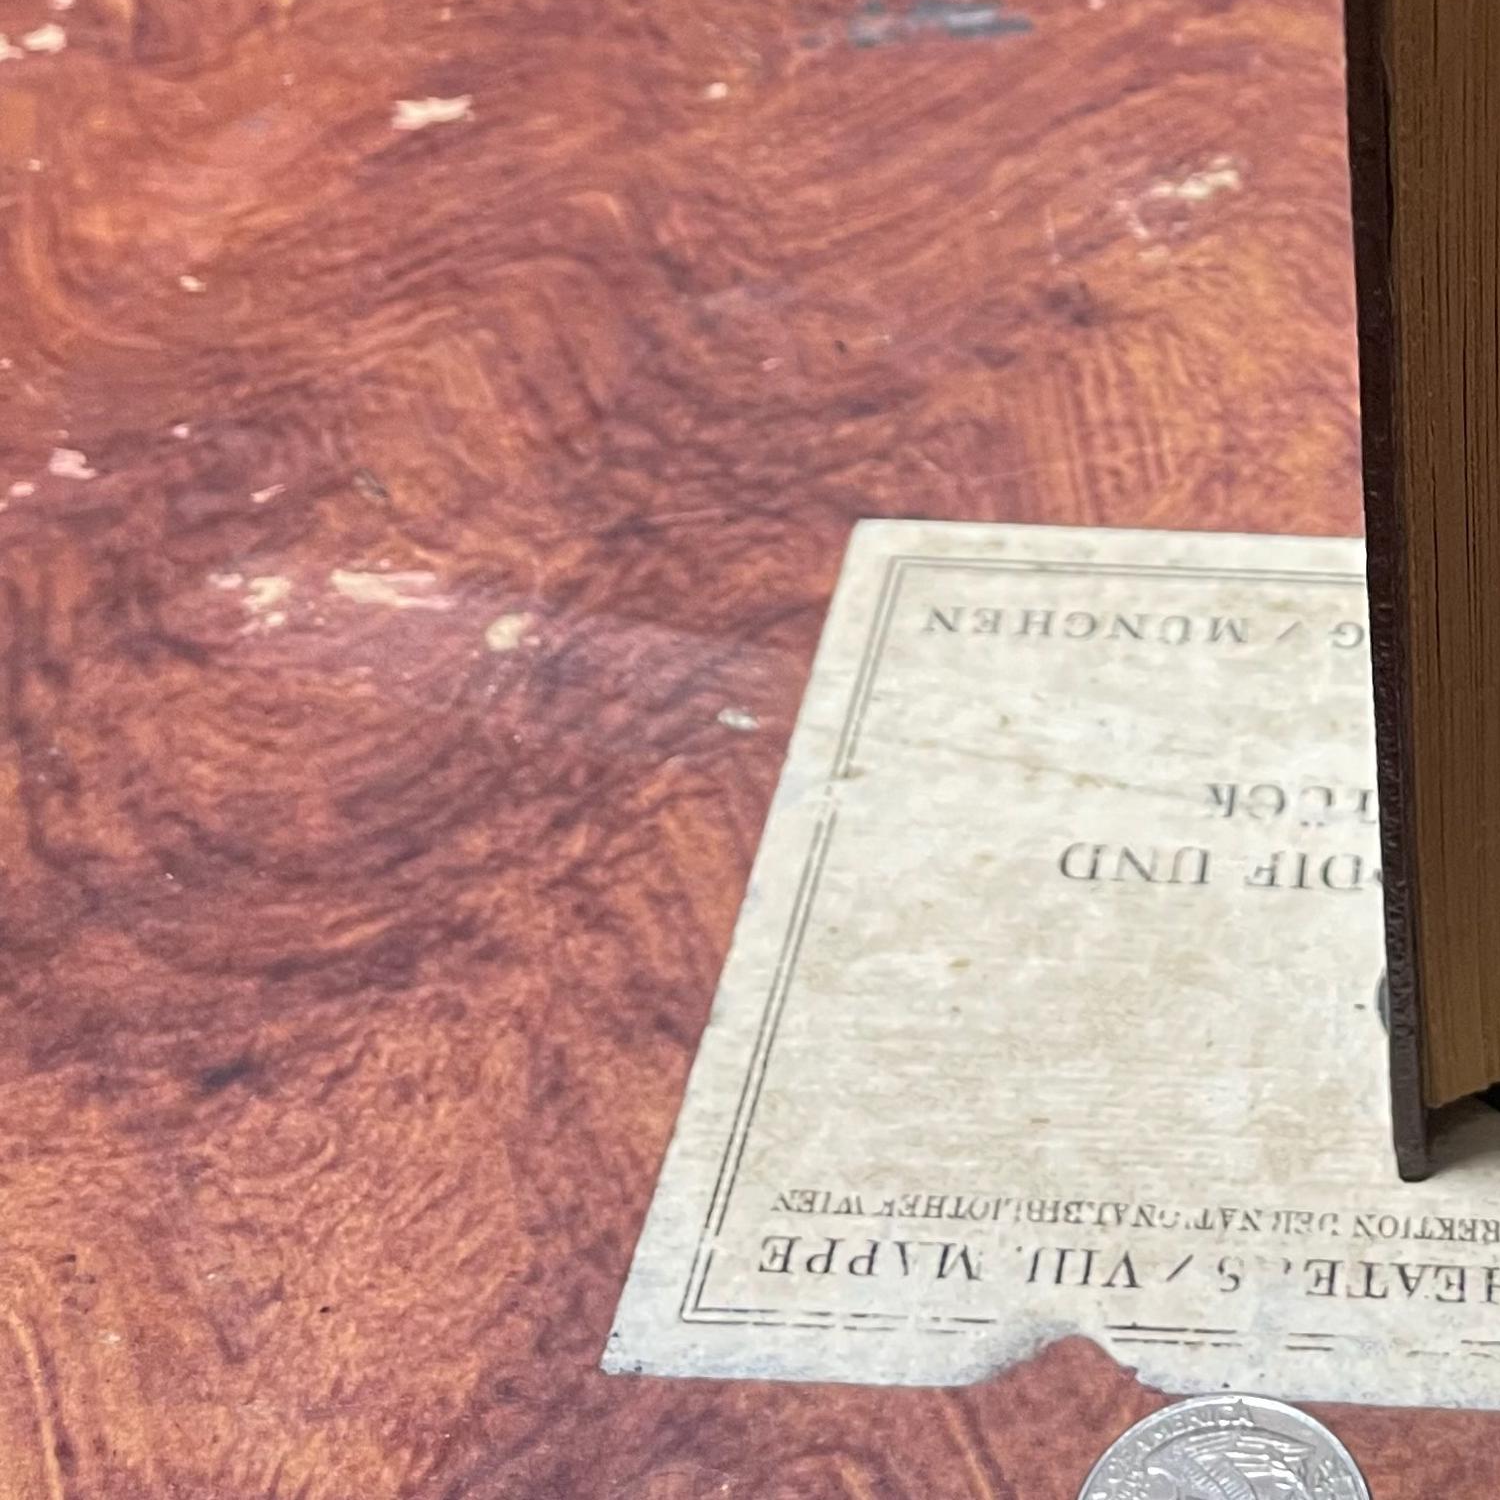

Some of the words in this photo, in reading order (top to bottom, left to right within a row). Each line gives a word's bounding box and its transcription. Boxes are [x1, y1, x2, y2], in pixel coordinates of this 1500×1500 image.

[922, 606, 1250, 648] MÜNCHEN
[1205, 783, 1377, 828] TÜCK
[1057, 843, 1210, 886] UND
[769, 1189, 865, 1216] WIEN
